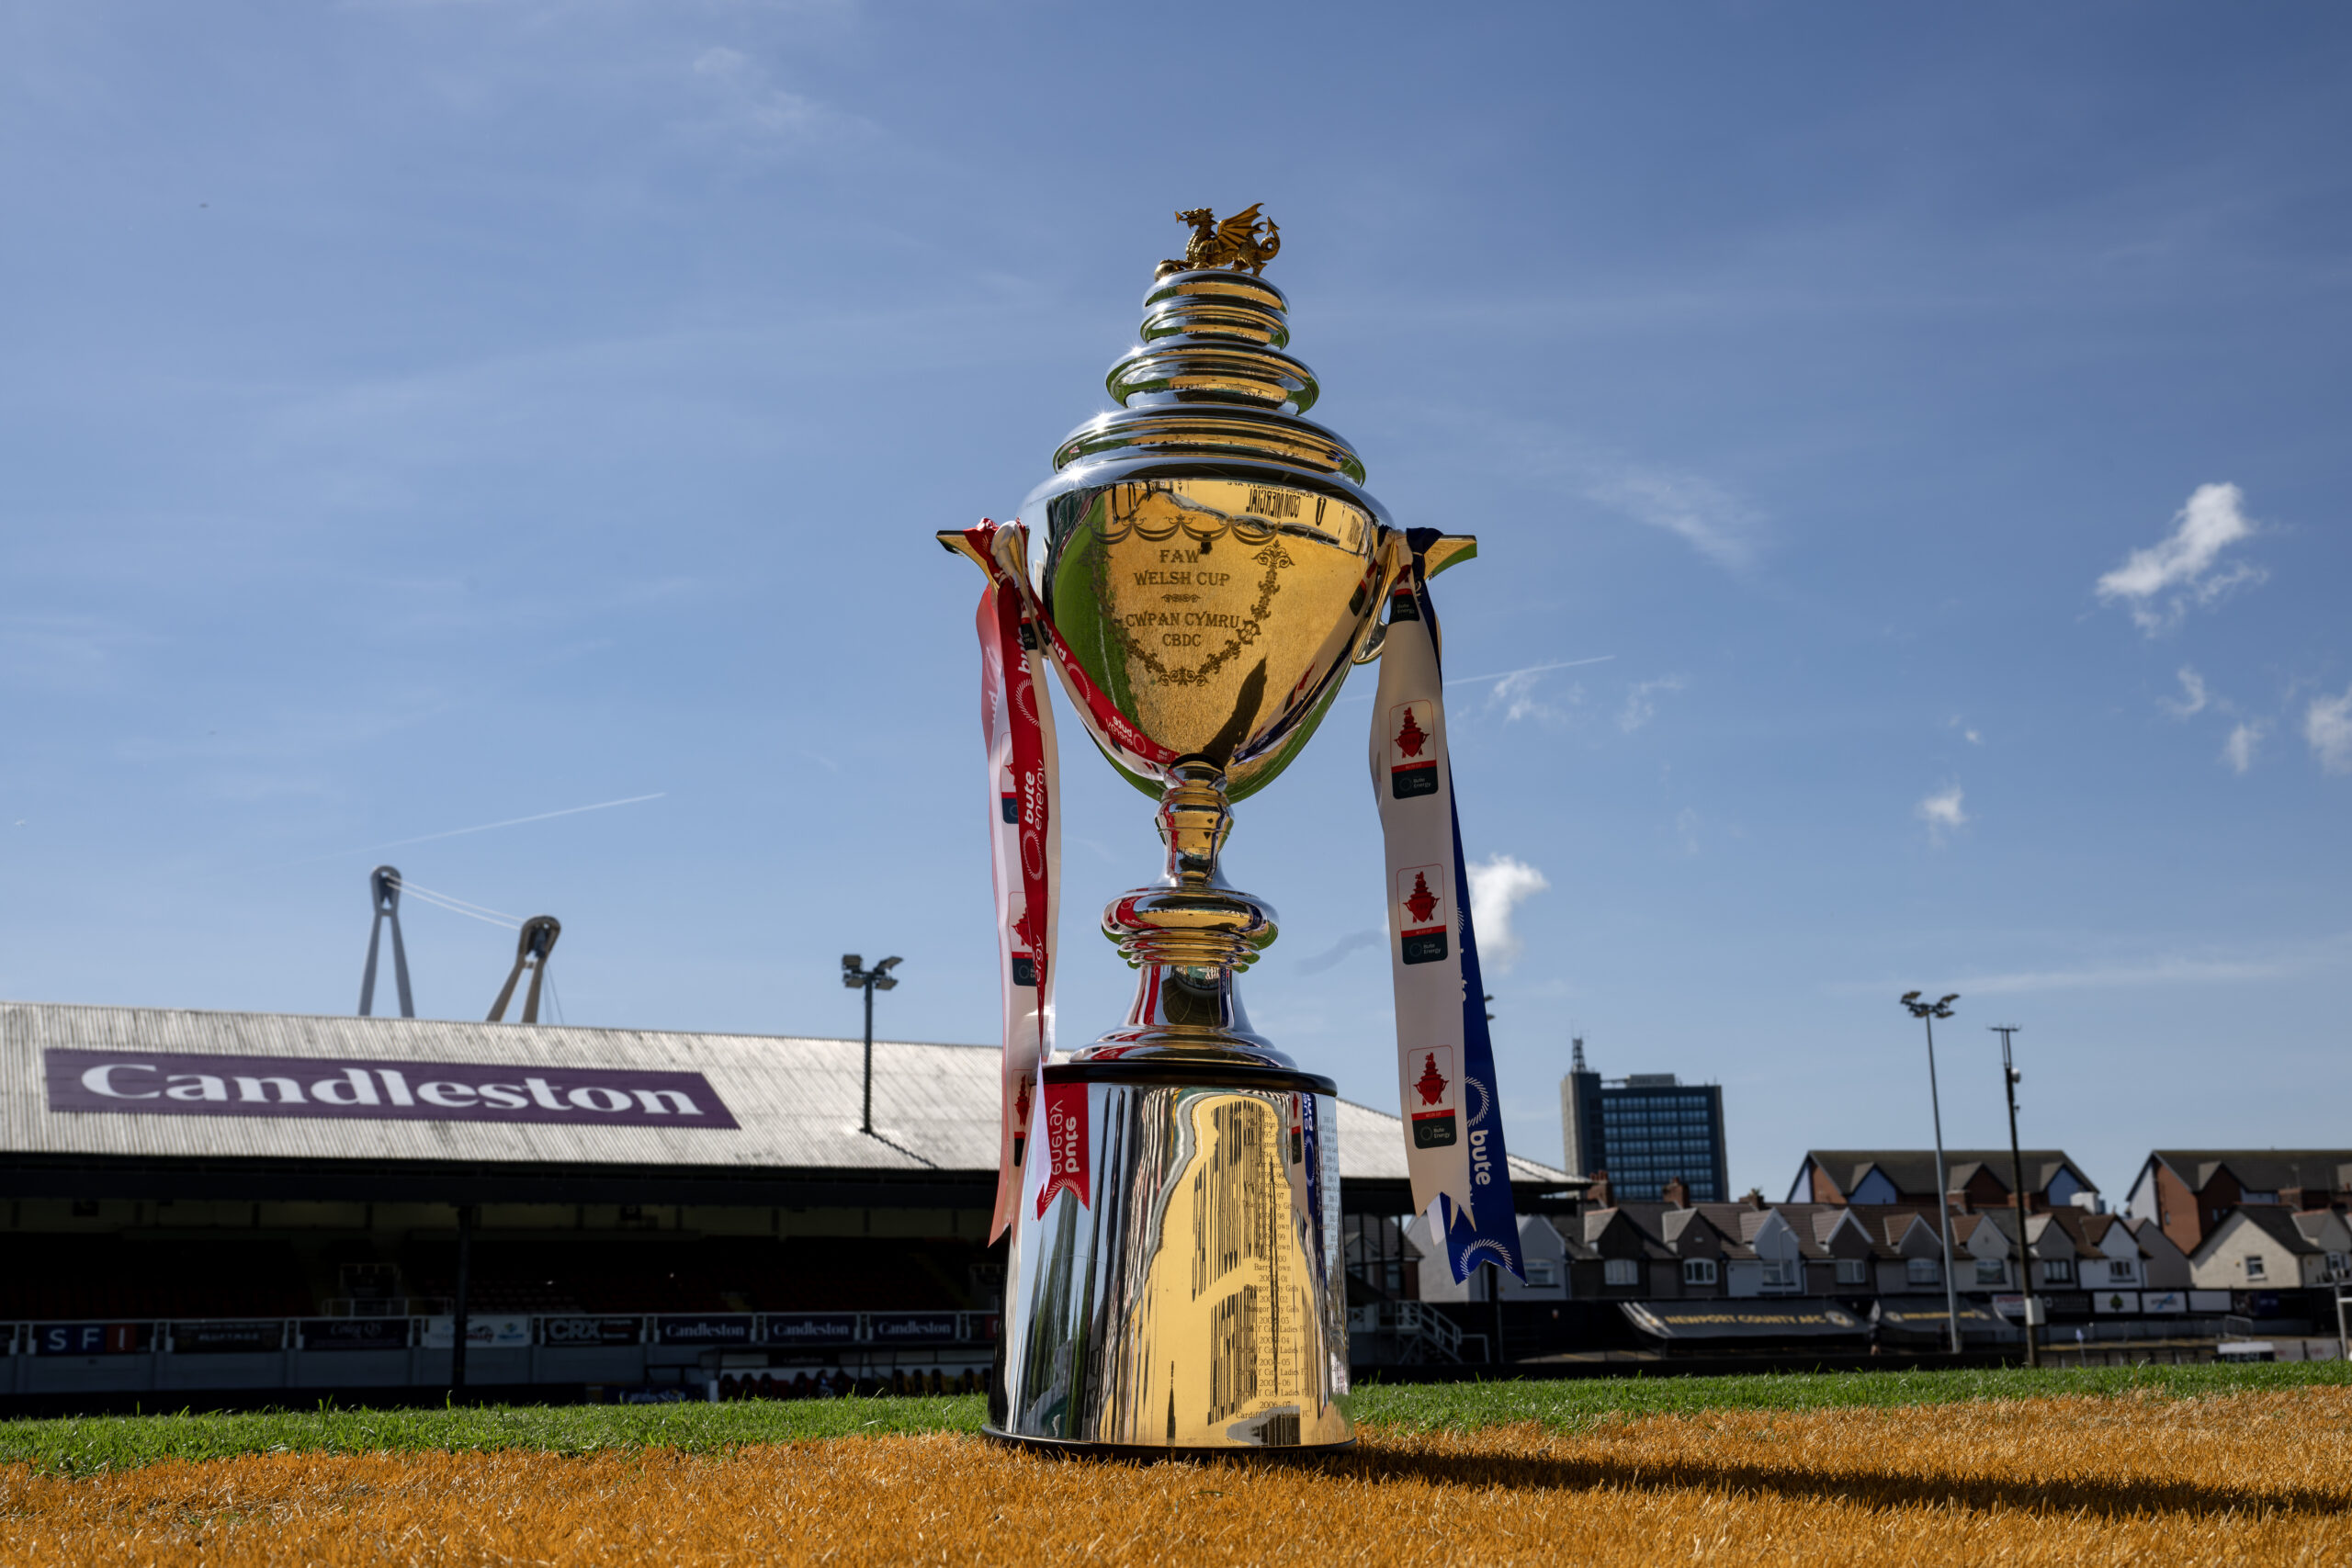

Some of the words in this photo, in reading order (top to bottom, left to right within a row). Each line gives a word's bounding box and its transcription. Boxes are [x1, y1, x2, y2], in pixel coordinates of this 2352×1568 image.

[1159, 549, 1201, 563] FAW
[1133, 570, 1192, 585] WELSH
[1196, 571, 1231, 586] CUP
[1125, 611, 1181, 626] CWPAN
[1184, 611, 1240, 628] CYMRU
[1161, 633, 1202, 647] CBDC
[1024, 771, 1035, 825] bute
[81, 1063, 704, 1116] Candleston
[1469, 1127, 1492, 1186] bute
[1664, 1314, 1736, 1325] NEWPORT
[1740, 1314, 1796, 1325] COUNTY
[1799, 1314, 1827, 1324] AFC
[549, 1319, 602, 1339] CRX
[664, 1323, 745, 1338] Candleston
[774, 1323, 850, 1337] Candleston
[878, 1321, 952, 1336] Candleston
[1279, 1325, 1298, 1333] Ladies
[1259, 1401, 1291, 1409] 2006-07
[1236, 1410, 1261, 1419] Cardiff
